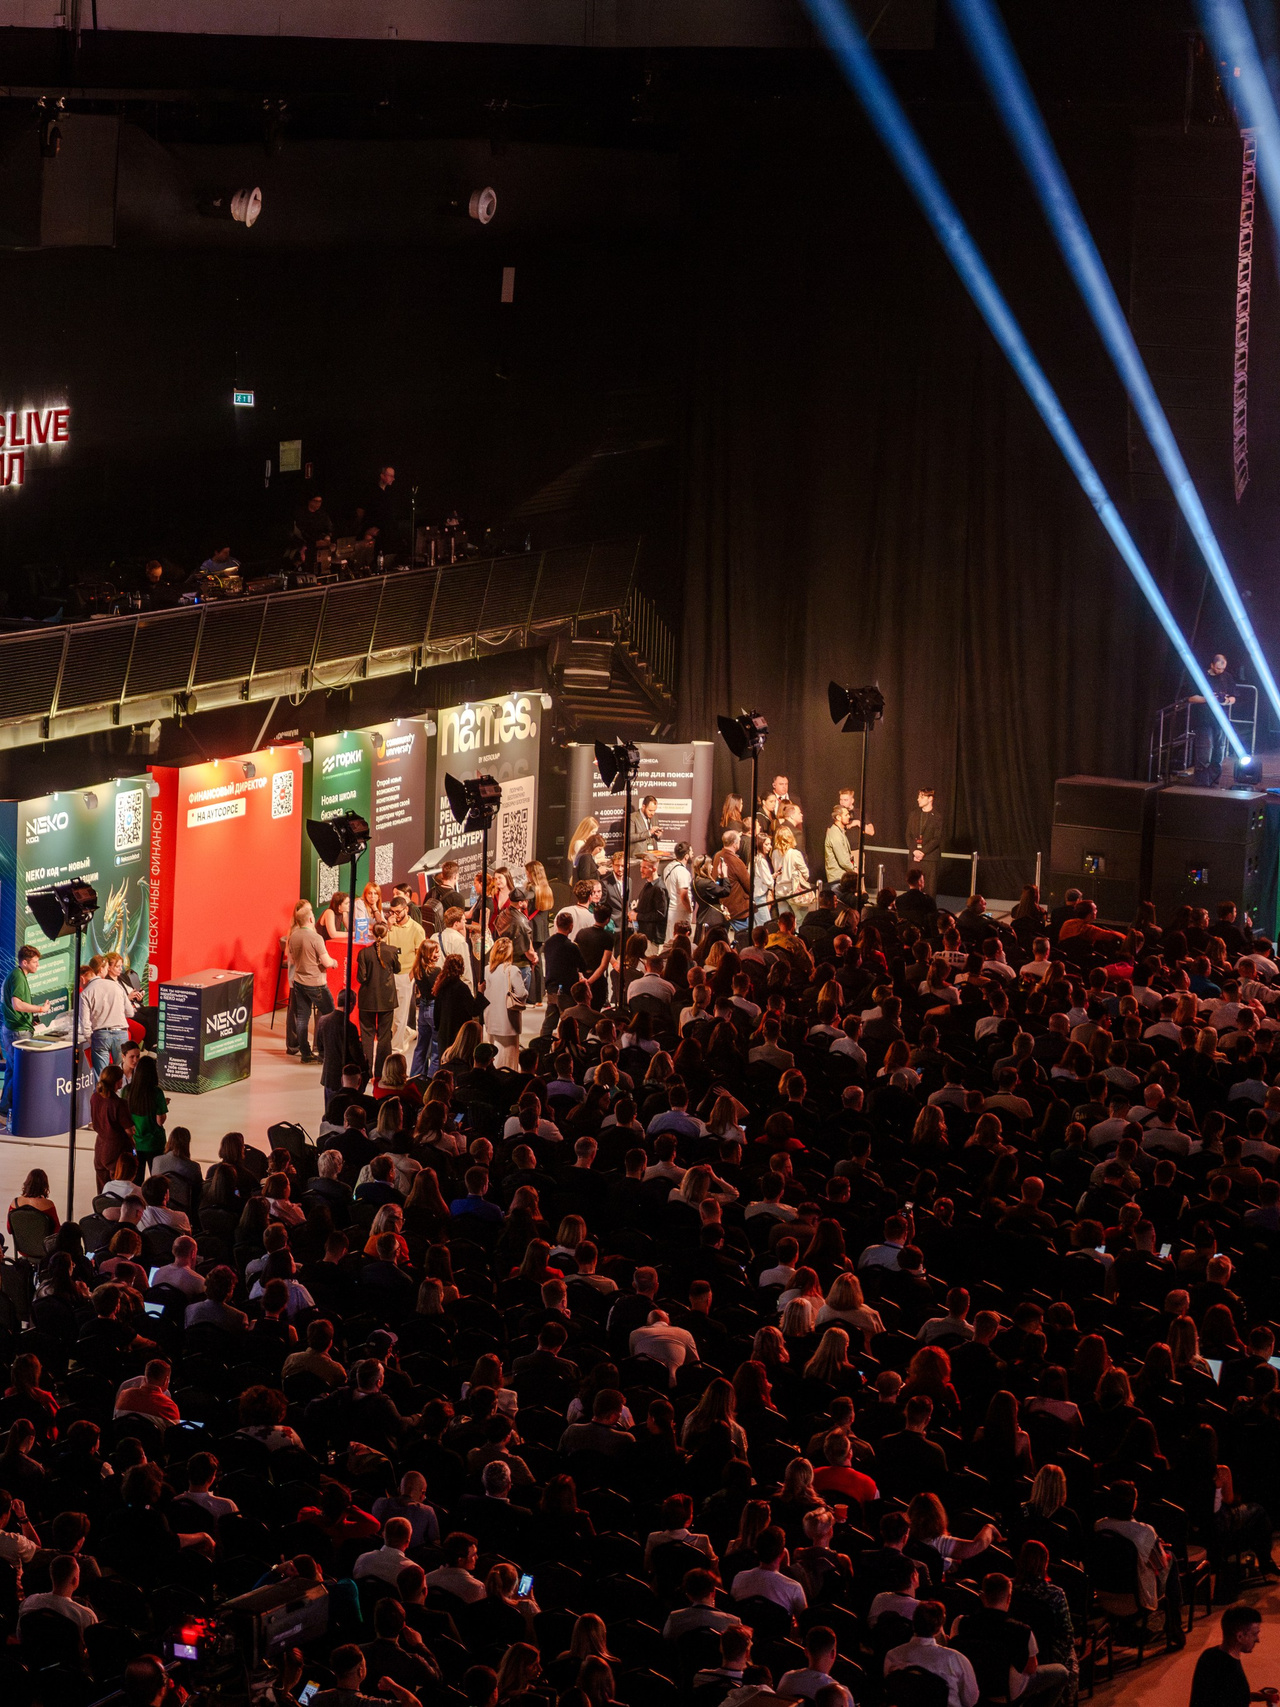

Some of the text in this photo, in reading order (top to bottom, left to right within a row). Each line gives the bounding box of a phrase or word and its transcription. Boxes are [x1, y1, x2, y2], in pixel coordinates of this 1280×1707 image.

[9, 408, 70, 446] LIVE
[188, 777, 268, 804] ФИНАНСОВЫЙ ДИРЕКТОР
[320, 789, 357, 806] Новая школа
[25, 811, 69, 837] NEKO
[196, 803, 239, 822] НА АУТСОРСЕ
[150, 810, 163, 874] ФИНАНСЫ
[25, 867, 46, 882] NEKO
[148, 879, 160, 954] НЕСКУЧНЫЕ
[206, 1006, 248, 1034] NEKO
[56, 1069, 94, 1097] Rostat
